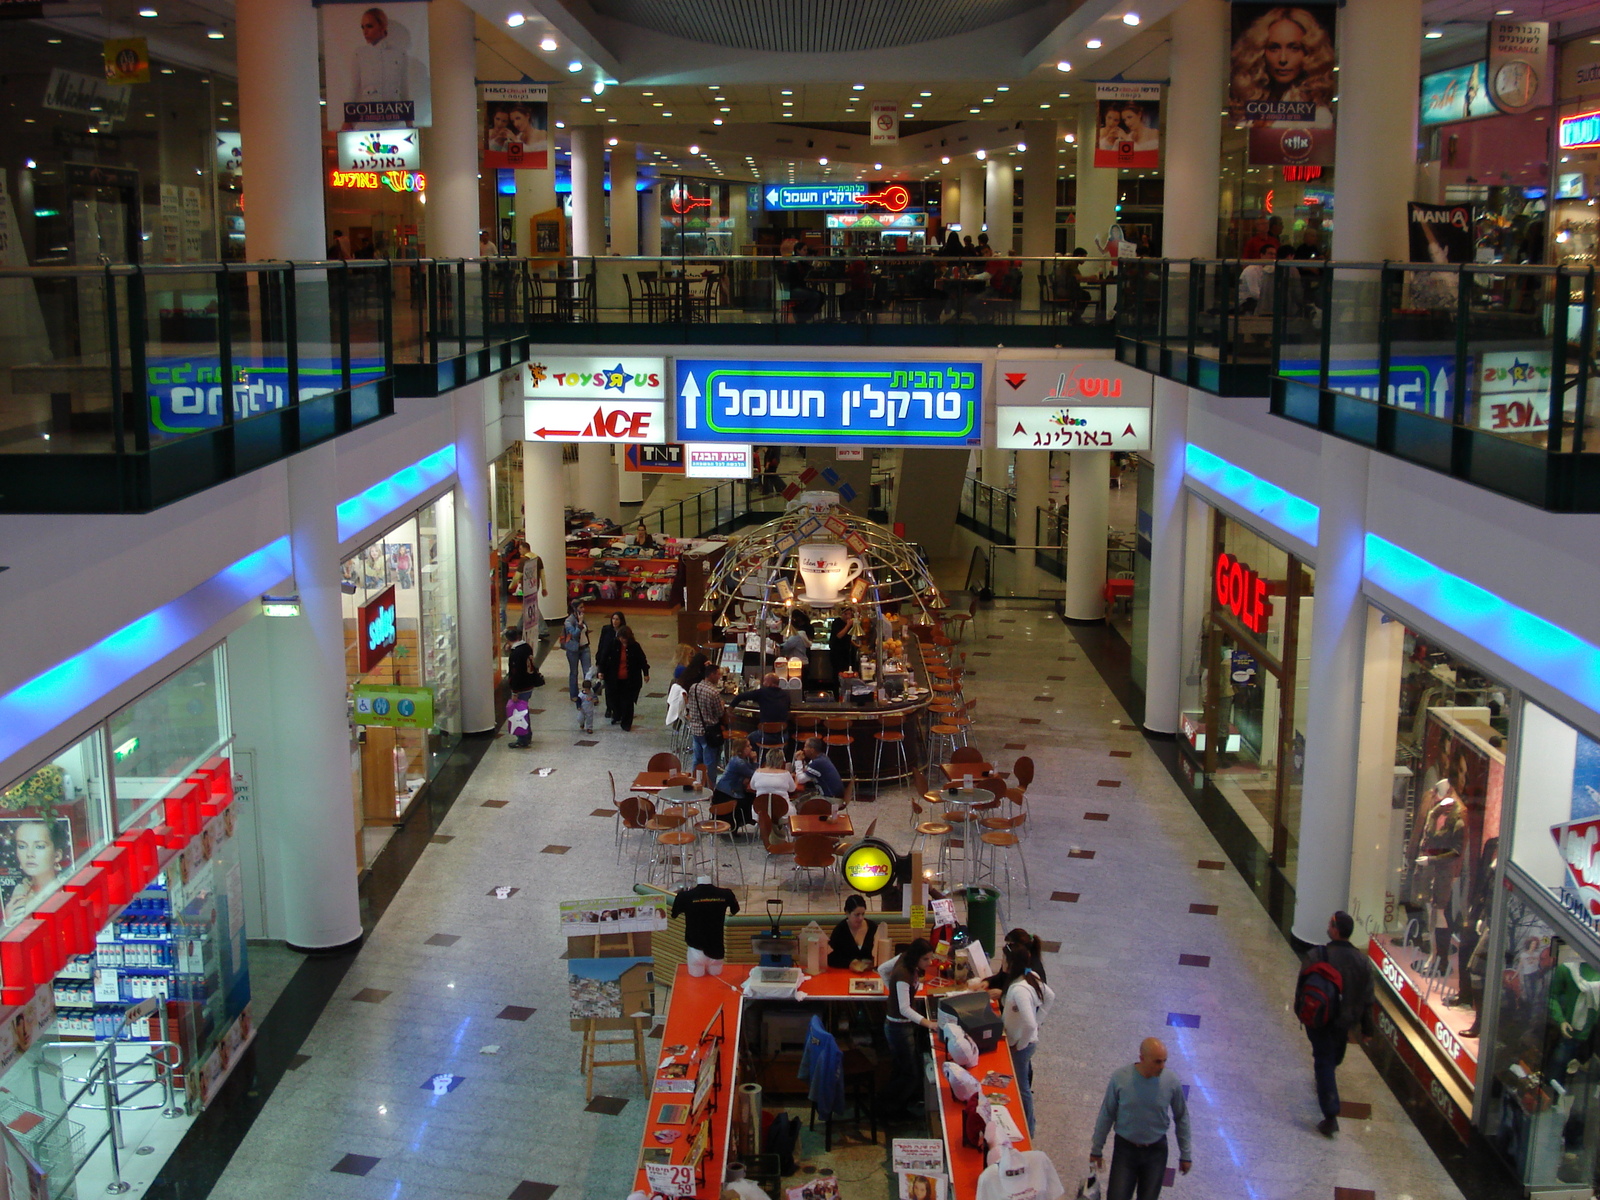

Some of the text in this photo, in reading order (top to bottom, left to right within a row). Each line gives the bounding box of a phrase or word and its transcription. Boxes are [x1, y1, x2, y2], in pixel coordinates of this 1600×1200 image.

[345, 102, 413, 115] GOLBARY
[1246, 102, 1315, 114] GOLBARY
[352, 156, 406, 169] באולינג
[333, 171, 378, 189] באולינג
[783, 190, 818, 203] חשמל
[1412, 209, 1466, 224] MANIA
[553, 373, 605, 386] TOYS
[634, 373, 660, 387] US
[890, 367, 975, 390] כל הבית
[718, 381, 961, 426] טרקלין חשמל
[581, 405, 652, 438] ACE
[1033, 427, 1113, 446] באולינג
[643, 446, 680, 461] TNT
[692, 452, 745, 461] פינת הבגד
[1216, 553, 1269, 633] GOLF
[1384, 890, 1395, 923] GOLF
[1381, 957, 1404, 991] GOLF
[1435, 1021, 1461, 1060] GOLF
[670, 1167, 691, 1184] 29
[678, 1185, 692, 1195] 59
